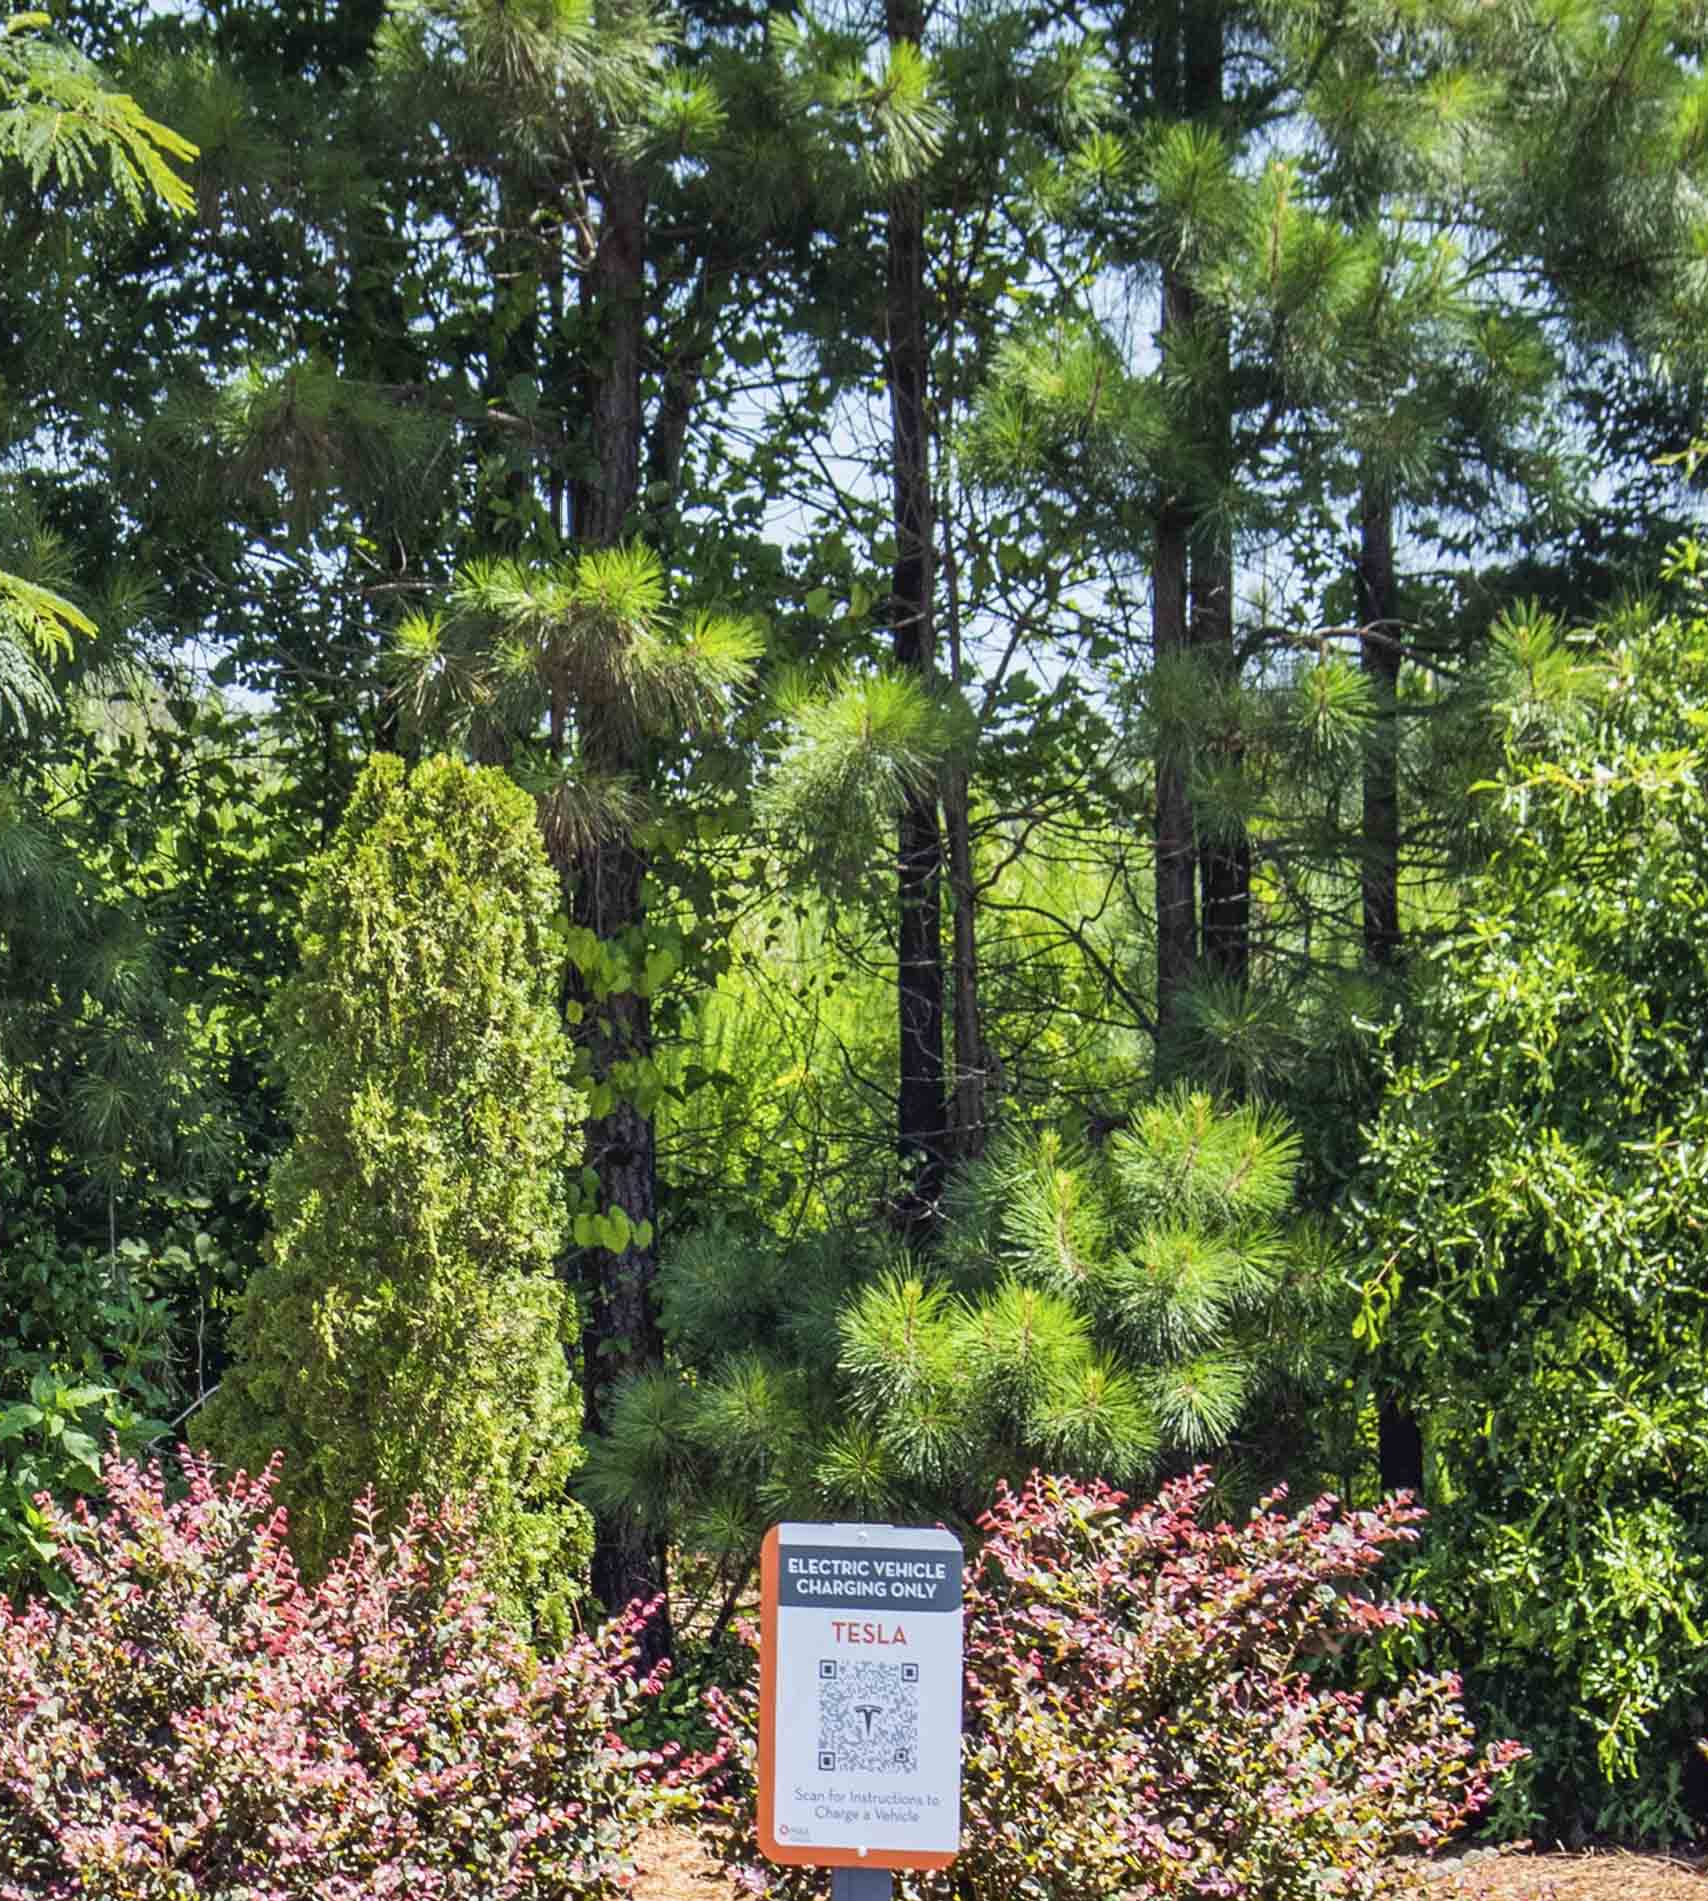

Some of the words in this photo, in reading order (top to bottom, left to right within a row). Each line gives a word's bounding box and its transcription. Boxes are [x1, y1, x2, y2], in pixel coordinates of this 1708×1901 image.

[788, 1558, 869, 1577] ELECTRIC
[873, 1561, 946, 1579] VEHICLE
[796, 1578, 886, 1598] CHARGING
[890, 1582, 937, 1599] ONLY
[831, 1621, 907, 1645] TESLA
[794, 1788, 825, 1801] Scan
[829, 1789, 847, 1801] for
[850, 1790, 924, 1806] Instructions
[927, 1793, 940, 1806] to
[815, 1806, 859, 1823] Charge
[864, 1811, 872, 1820] a
[874, 1808, 920, 1823] Vehicle
